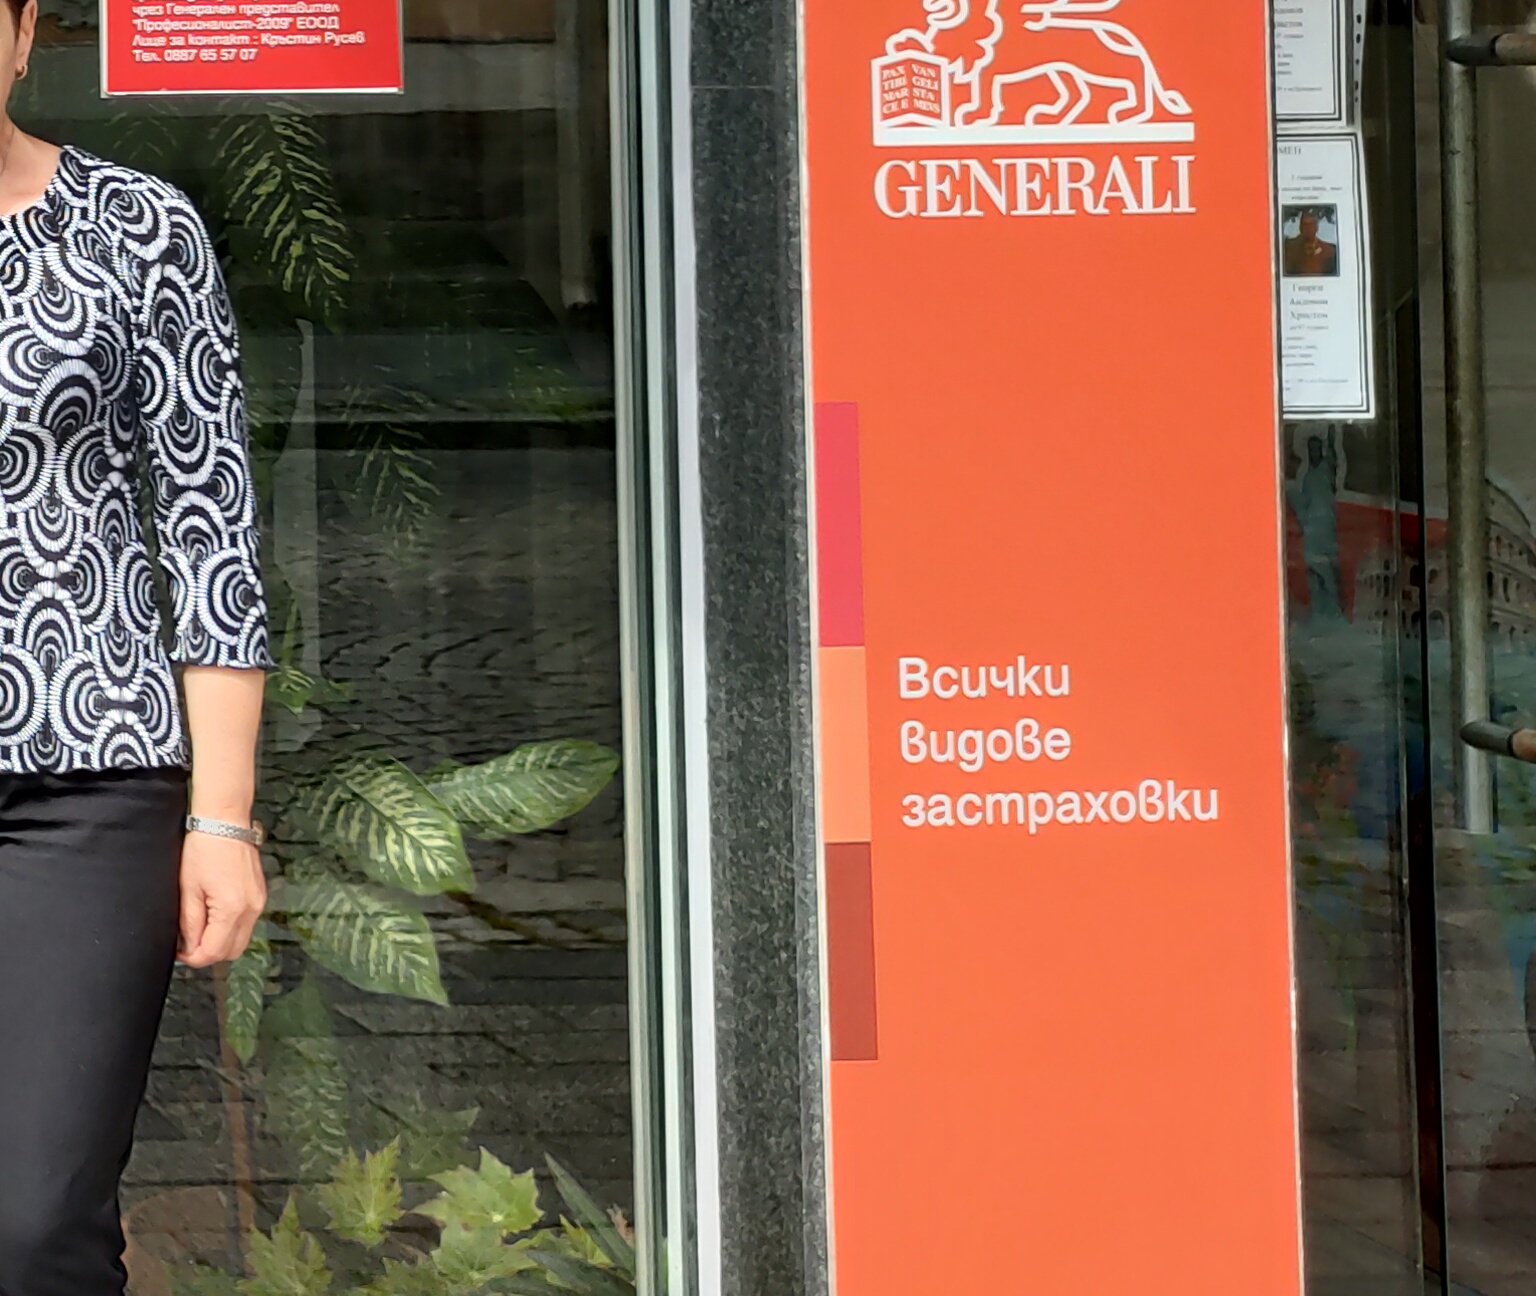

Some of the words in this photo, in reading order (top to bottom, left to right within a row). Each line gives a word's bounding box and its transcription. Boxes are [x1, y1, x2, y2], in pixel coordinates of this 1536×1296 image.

[296, 16, 340, 30] ЕООД
[220, 49, 238, 61] 57
[874, 156, 1196, 218] GENERALI
[898, 656, 1070, 699] Всички
[900, 718, 1071, 772] видове
[902, 780, 1218, 835] застраховки
